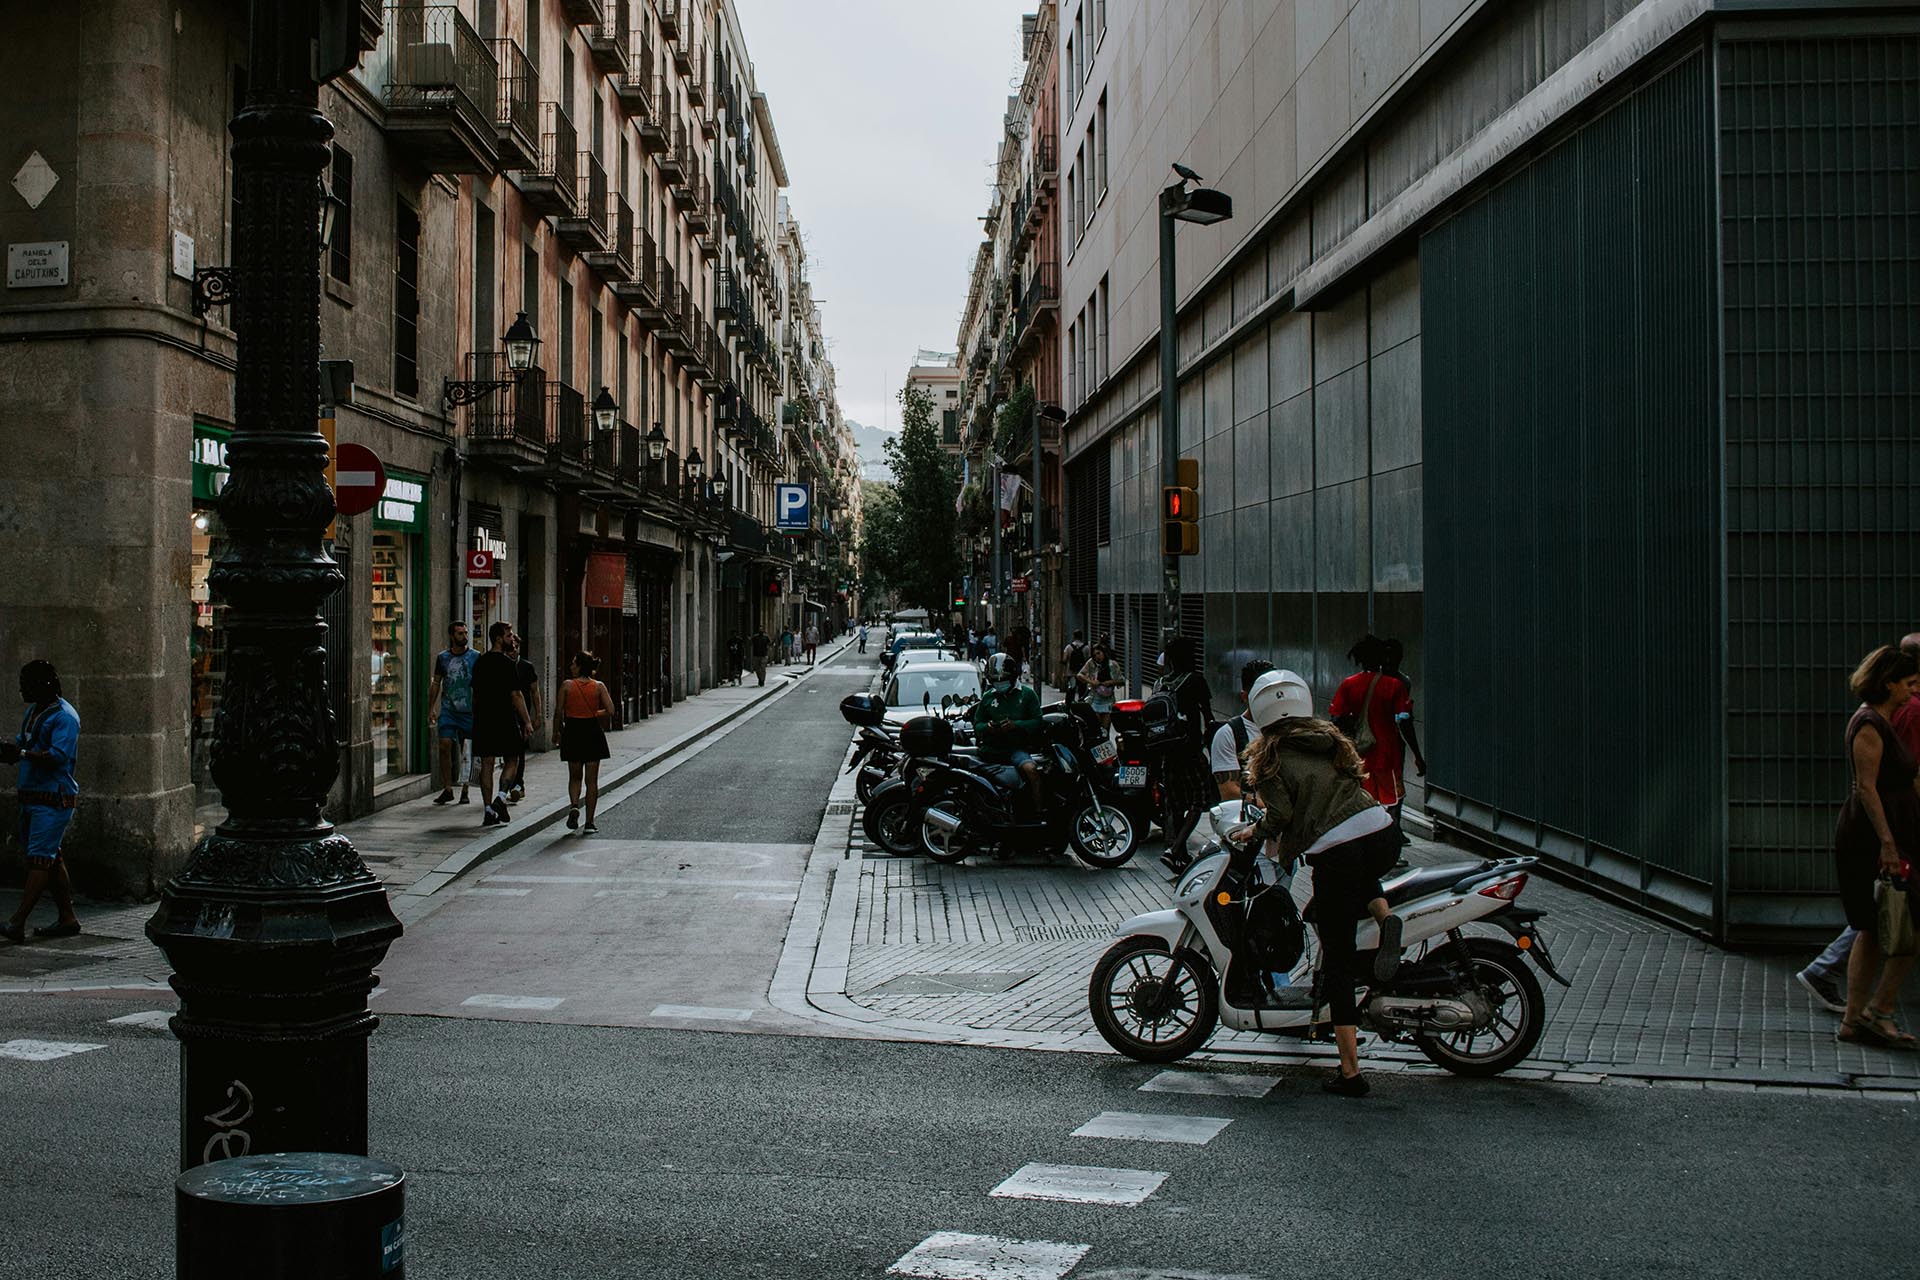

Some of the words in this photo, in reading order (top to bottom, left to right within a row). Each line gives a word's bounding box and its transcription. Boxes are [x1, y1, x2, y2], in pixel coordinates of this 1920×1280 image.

[22, 248, 53, 257] RAMBLA
[27, 258, 47, 266] DELS
[15, 267, 60, 280] CAPUTXINS
[780, 487, 807, 520] P
[1125, 767, 1146, 776] 6005
[1124, 776, 1140, 785] FGR
